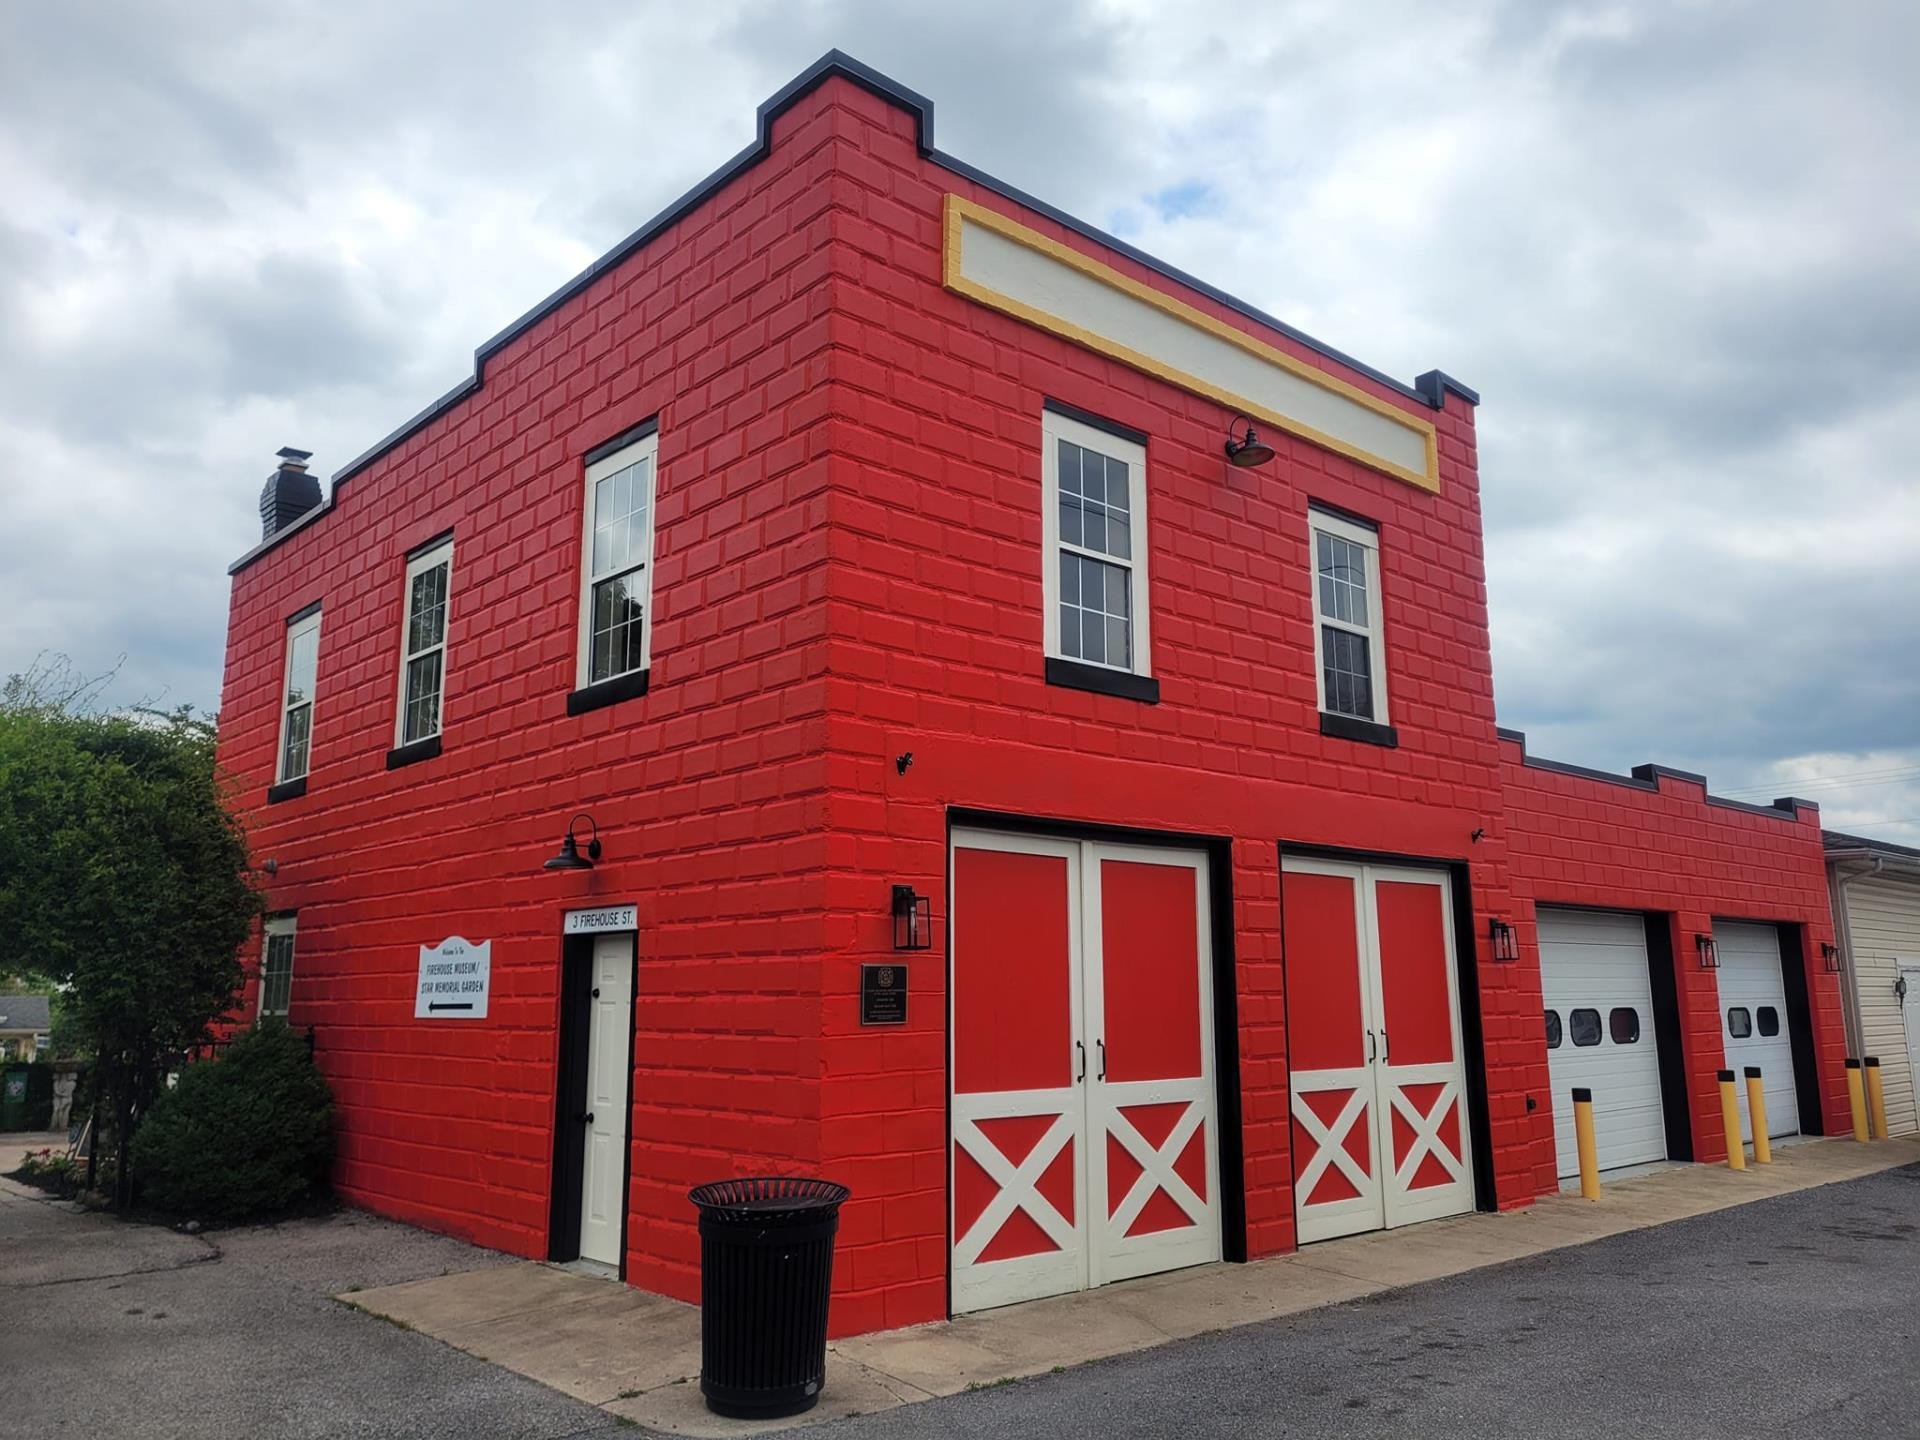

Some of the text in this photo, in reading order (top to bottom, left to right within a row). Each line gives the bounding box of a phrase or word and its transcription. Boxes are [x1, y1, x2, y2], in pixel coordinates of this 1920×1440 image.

[573, 911, 633, 928] 3 FIREHOUSE ST.
[426, 963, 453, 976] FIREHOUSE
[435, 981, 460, 993] MEMORIAL
[461, 980, 484, 993] GARDEN
